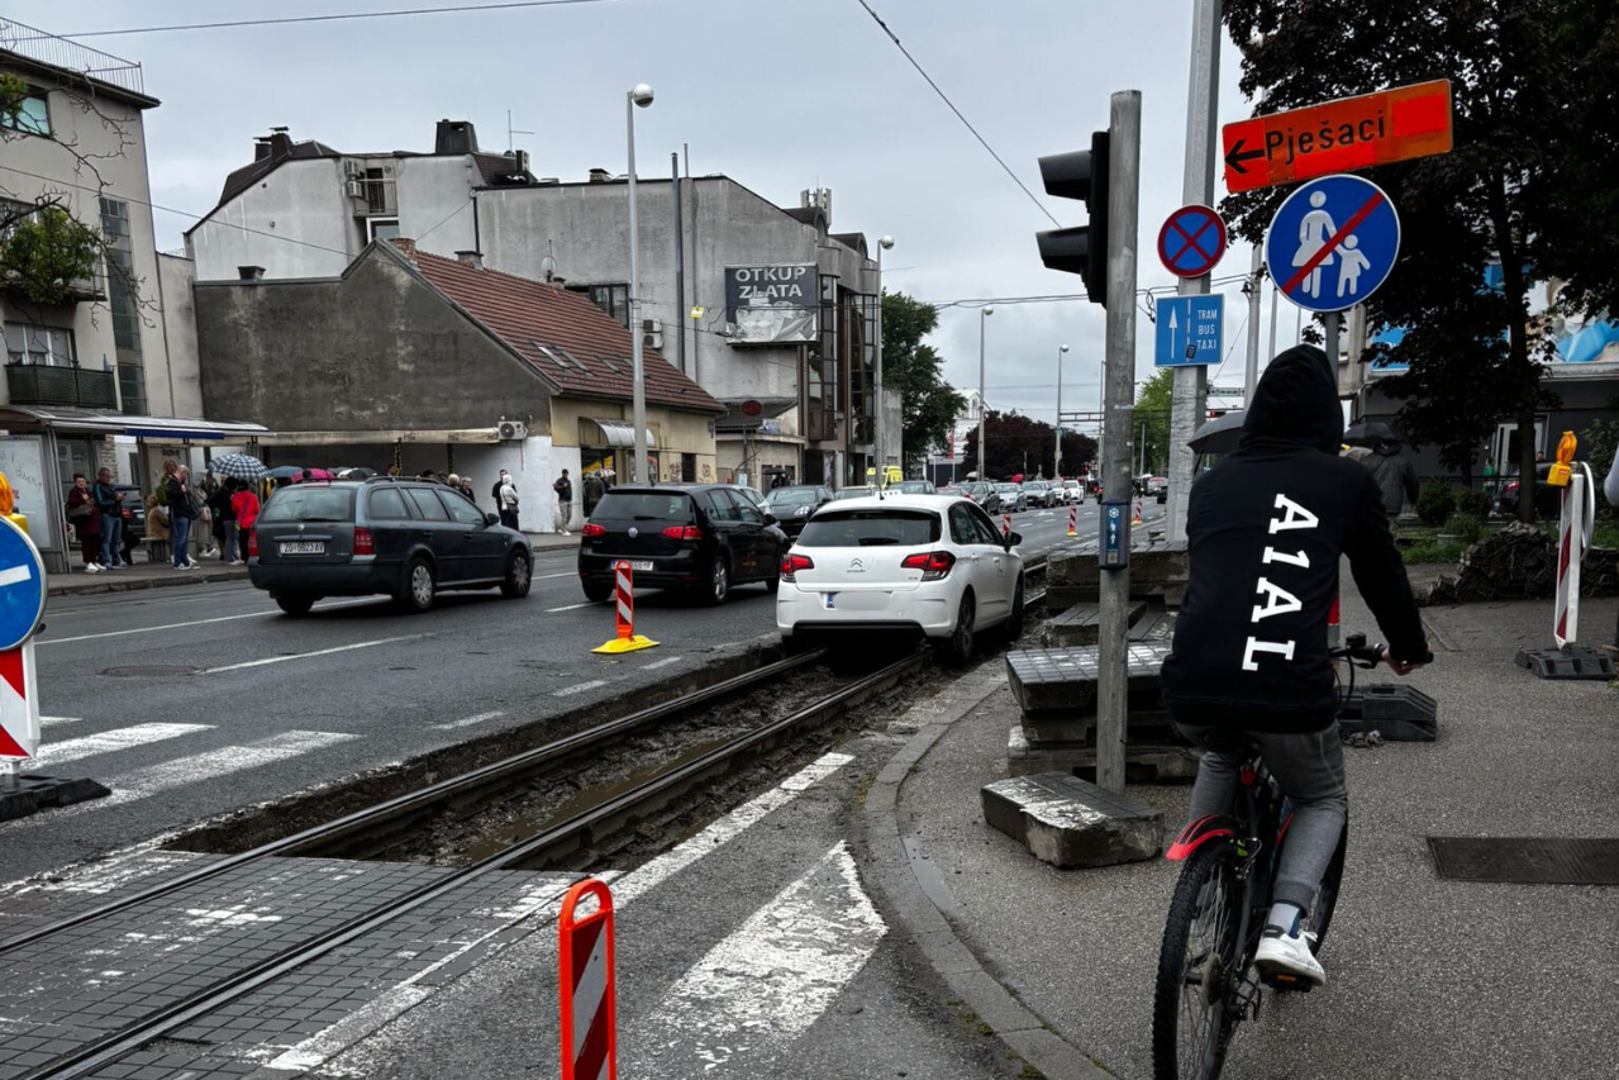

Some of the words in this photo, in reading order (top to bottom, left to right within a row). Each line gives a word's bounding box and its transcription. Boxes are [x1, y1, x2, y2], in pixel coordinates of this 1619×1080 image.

[1266, 110, 1385, 165] Pješaci
[736, 267, 806, 282] OTKUP
[739, 284, 802, 299] ZLATA
[1197, 309, 1218, 320] TRAM
[1198, 325, 1216, 335] BUS
[1197, 339, 1217, 350] TAXI
